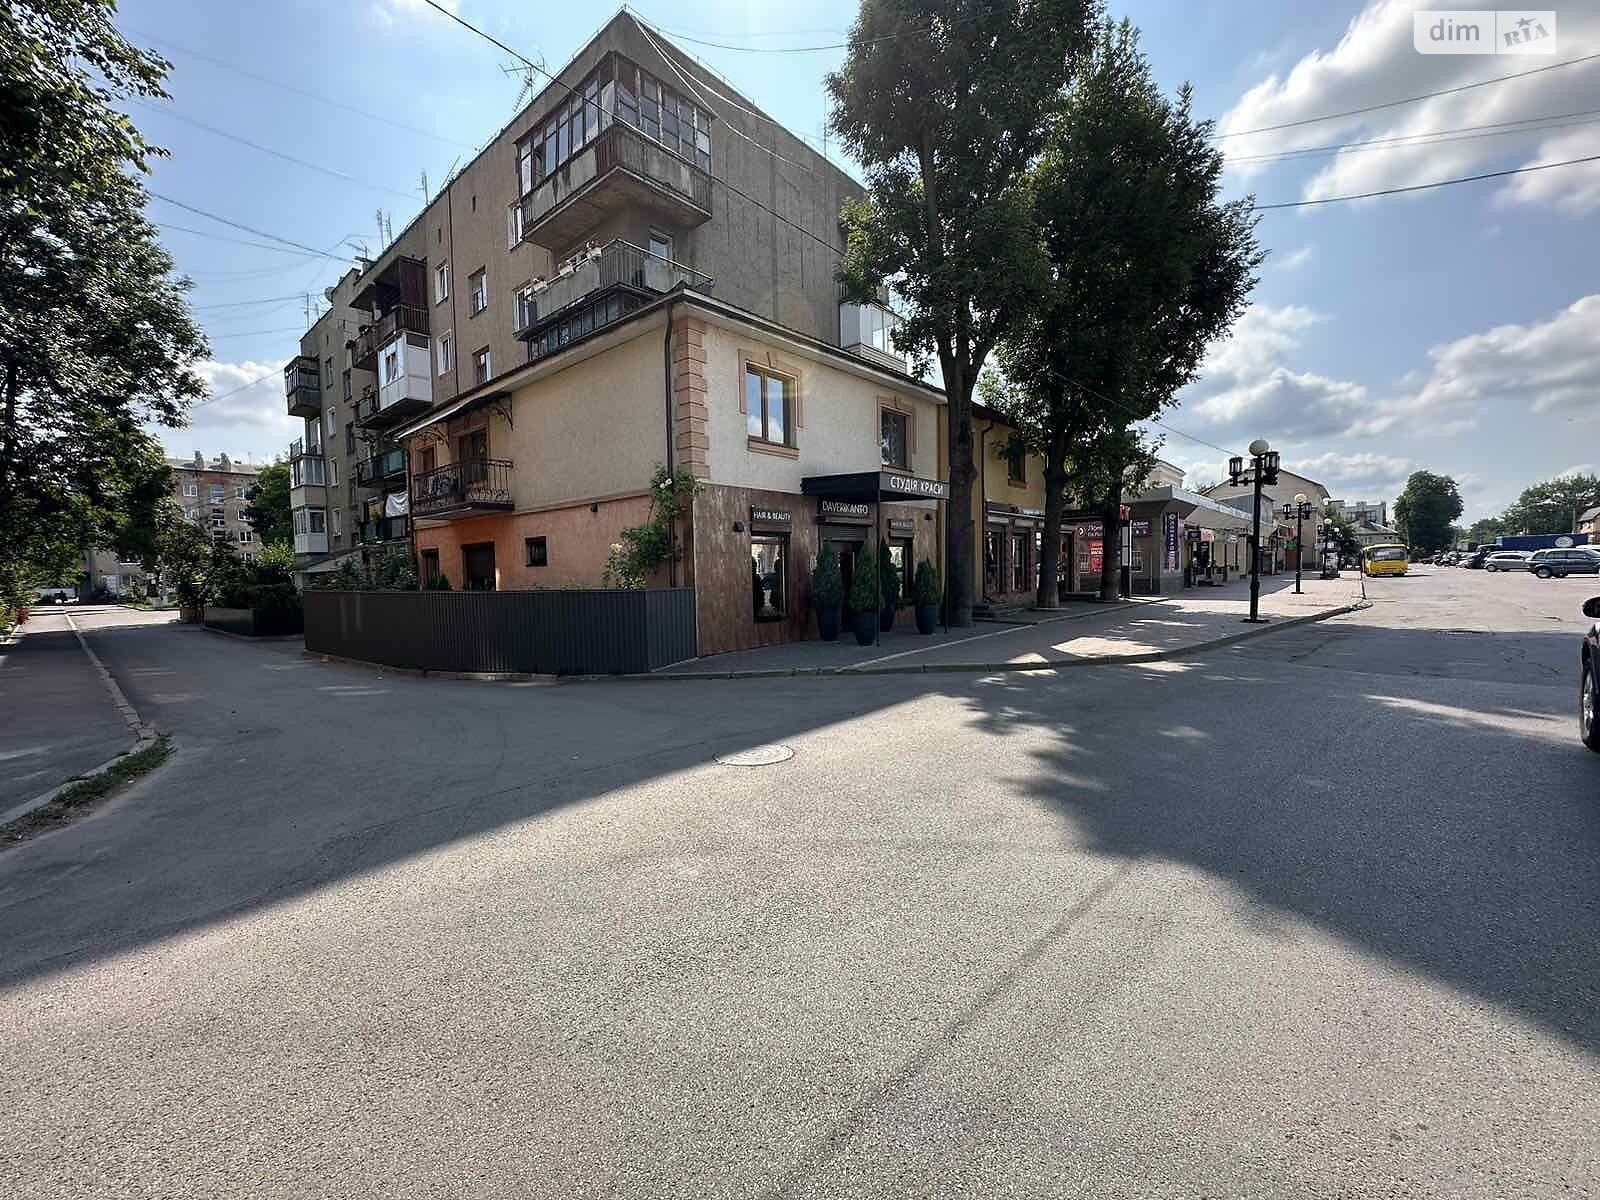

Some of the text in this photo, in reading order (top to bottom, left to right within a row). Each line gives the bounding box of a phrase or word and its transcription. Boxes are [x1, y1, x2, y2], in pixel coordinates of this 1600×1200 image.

[890, 476, 918, 492] СТУДІЯ
[753, 511, 767, 520] HAIR
[772, 511, 792, 521] BEAUTY
